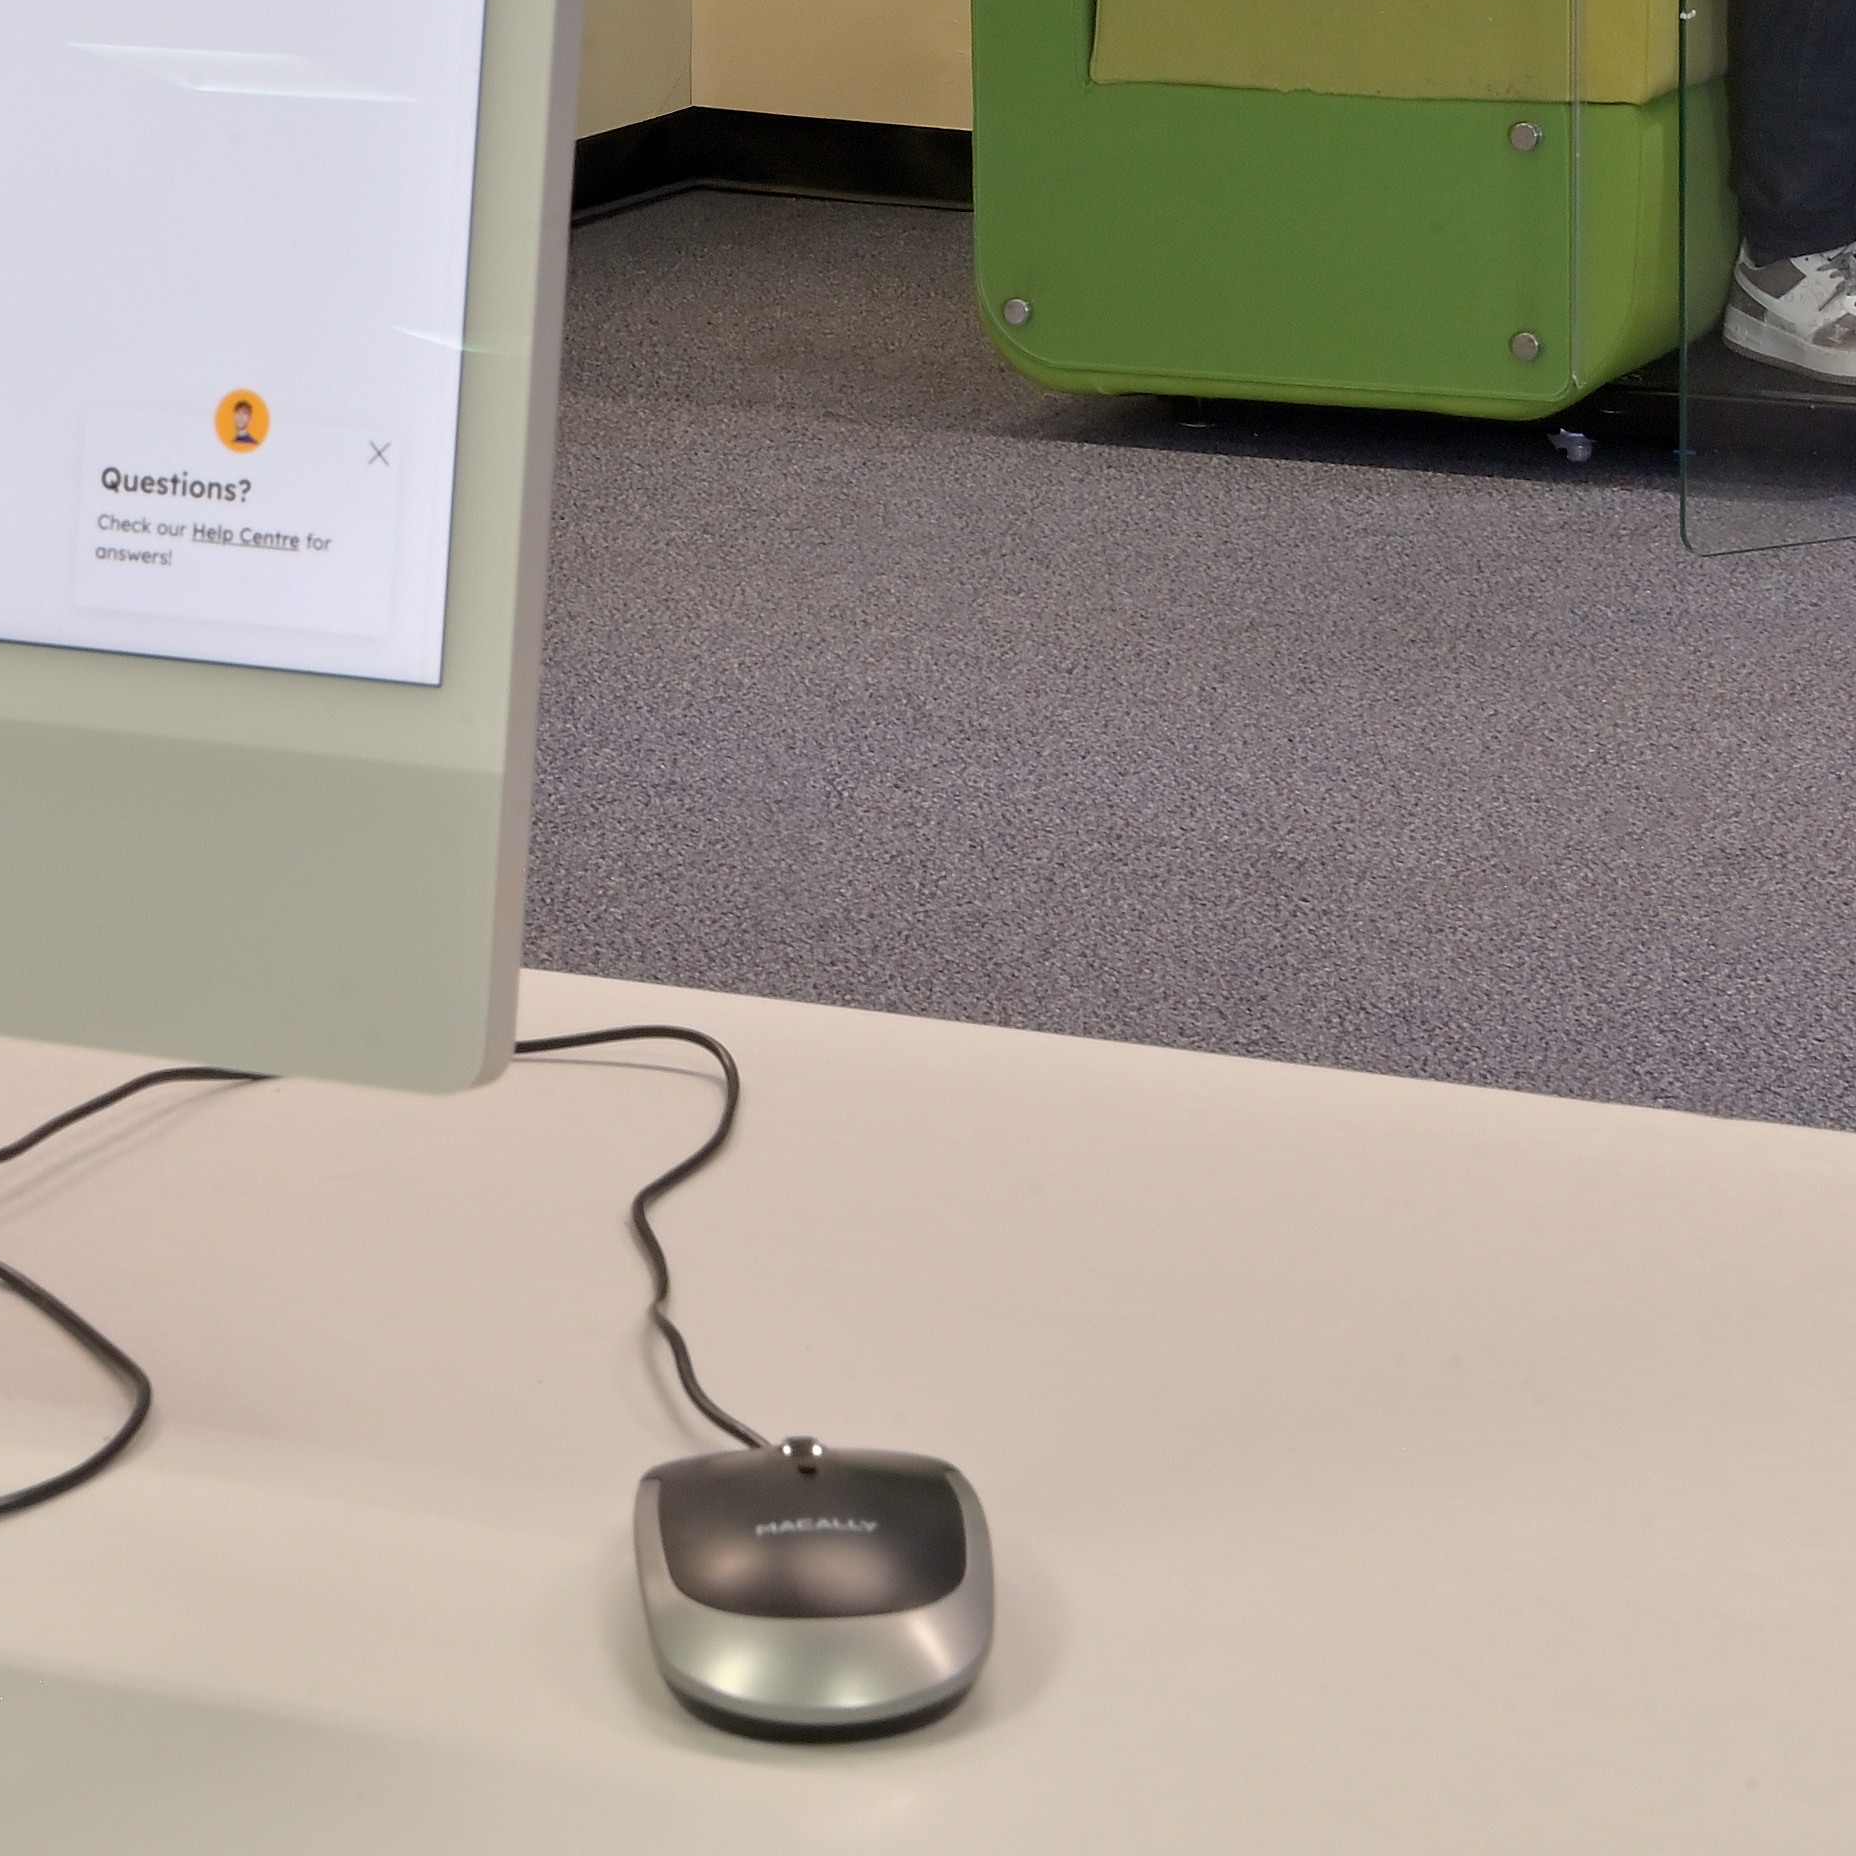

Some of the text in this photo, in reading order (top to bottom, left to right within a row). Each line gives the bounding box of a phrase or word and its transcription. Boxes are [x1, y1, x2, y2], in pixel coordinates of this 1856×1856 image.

[101, 466, 252, 503] Questions?
[97, 513, 332, 551] Check our Help Centre for
[95, 545, 173, 566] answers!
[756, 1517, 879, 1536] MACALLY
